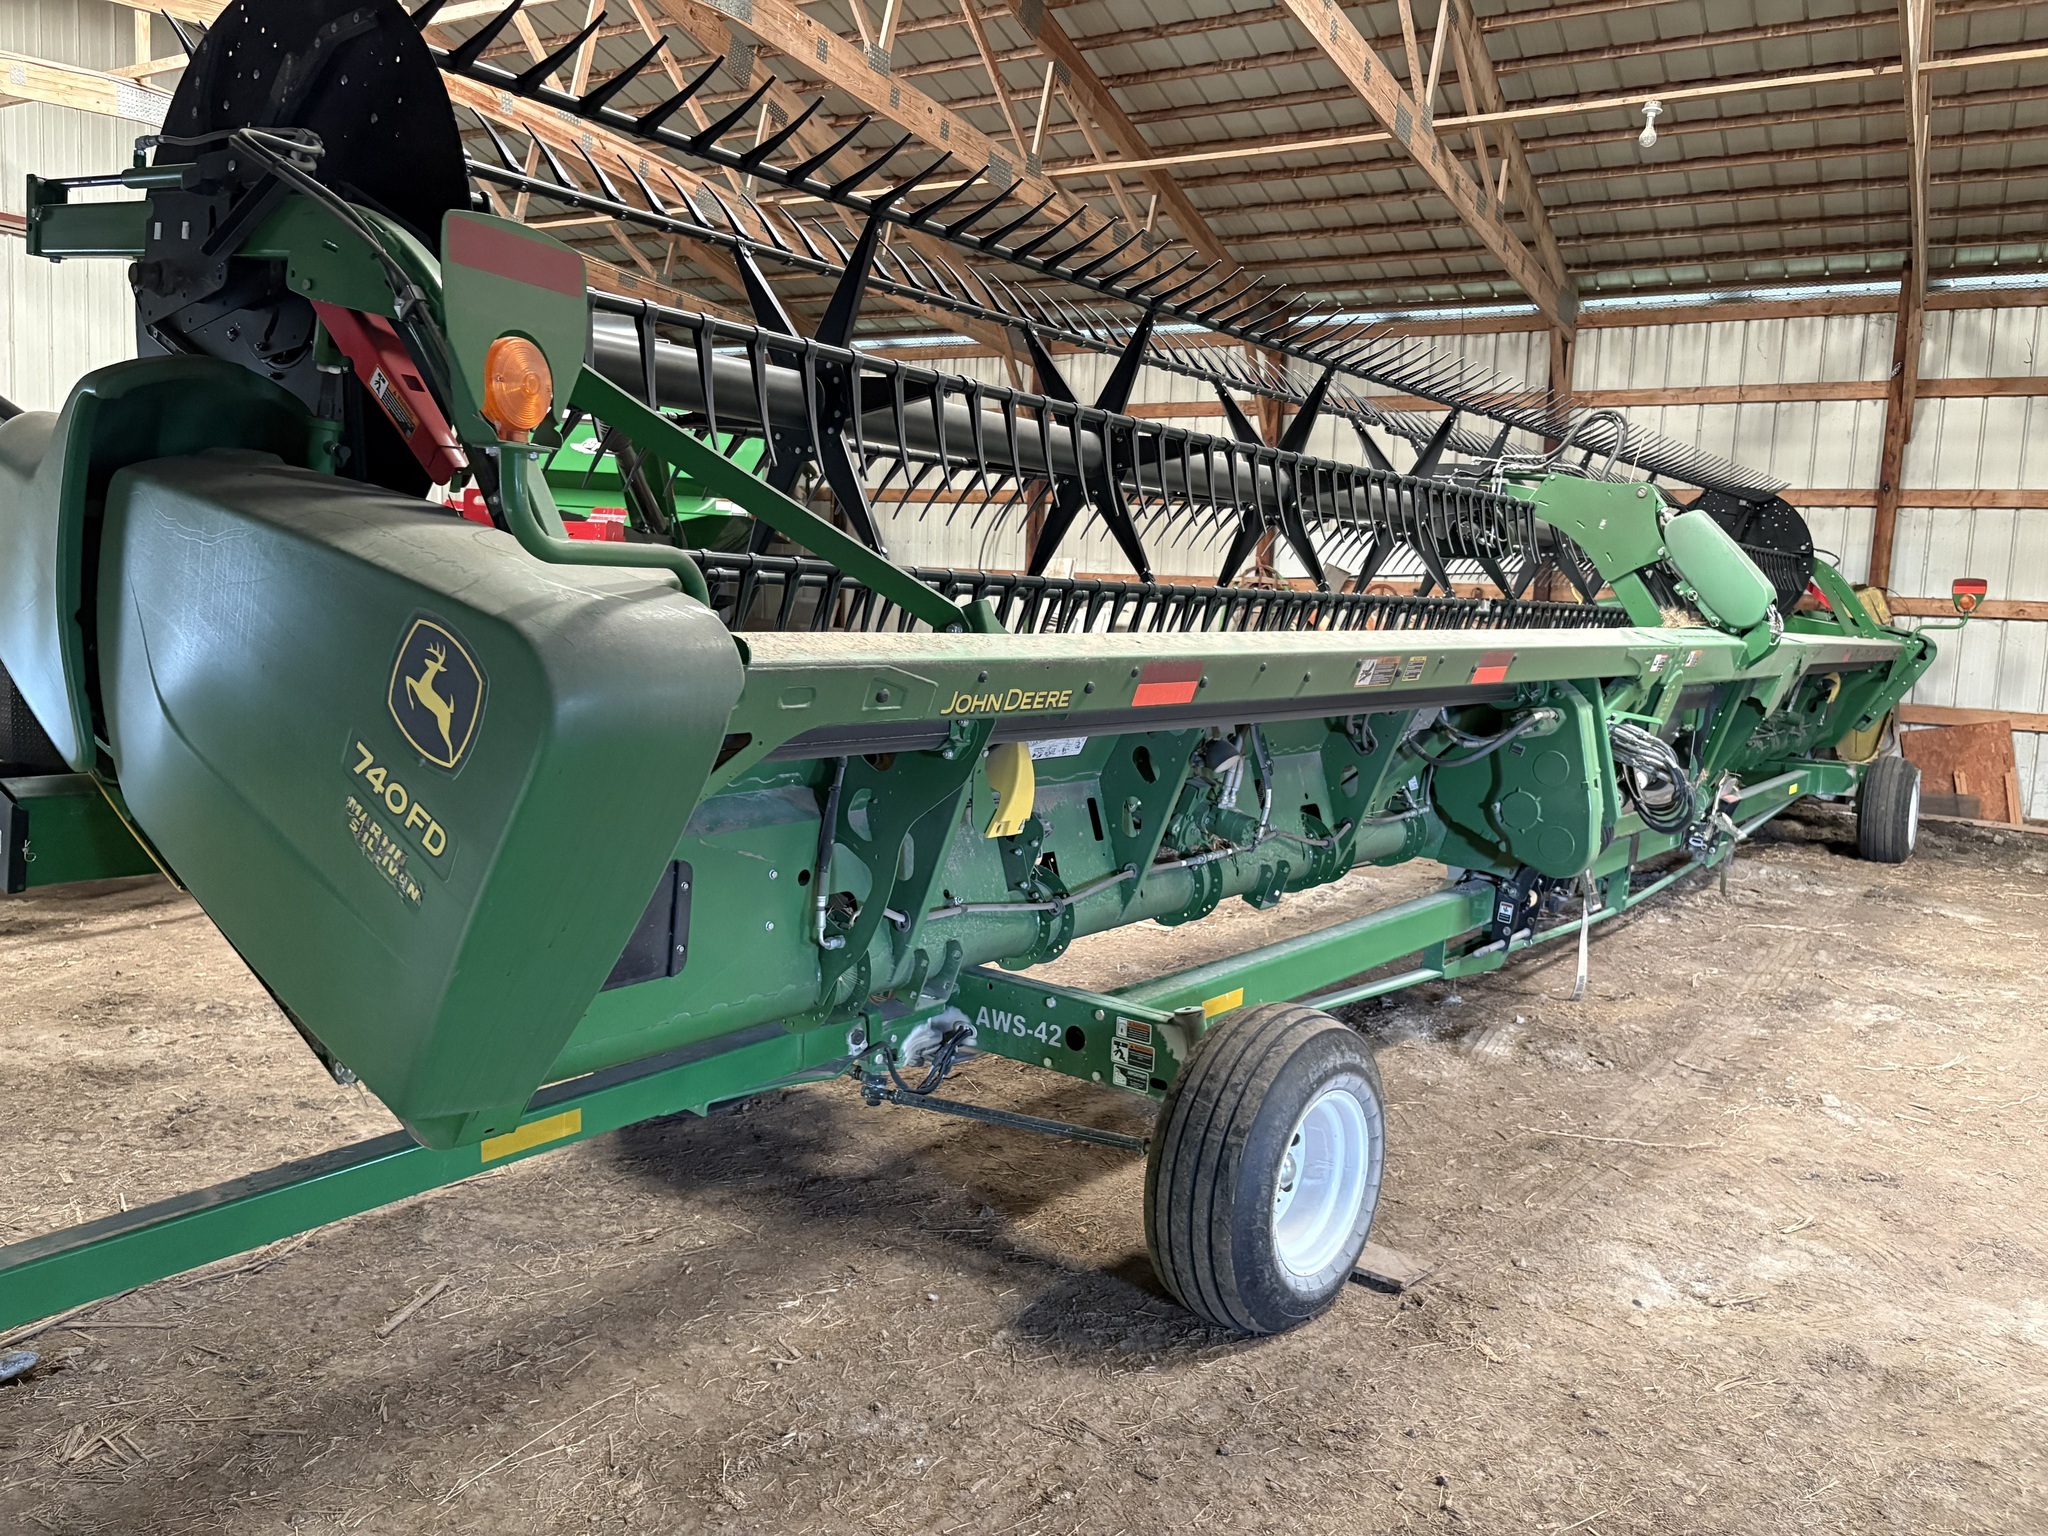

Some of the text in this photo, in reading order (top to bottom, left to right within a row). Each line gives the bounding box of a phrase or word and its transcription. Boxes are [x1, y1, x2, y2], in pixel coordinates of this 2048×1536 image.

[940, 688, 1073, 714] JOHN DEERE
[353, 740, 447, 857] 740FD
[975, 1006, 1062, 1048] AWS-42
